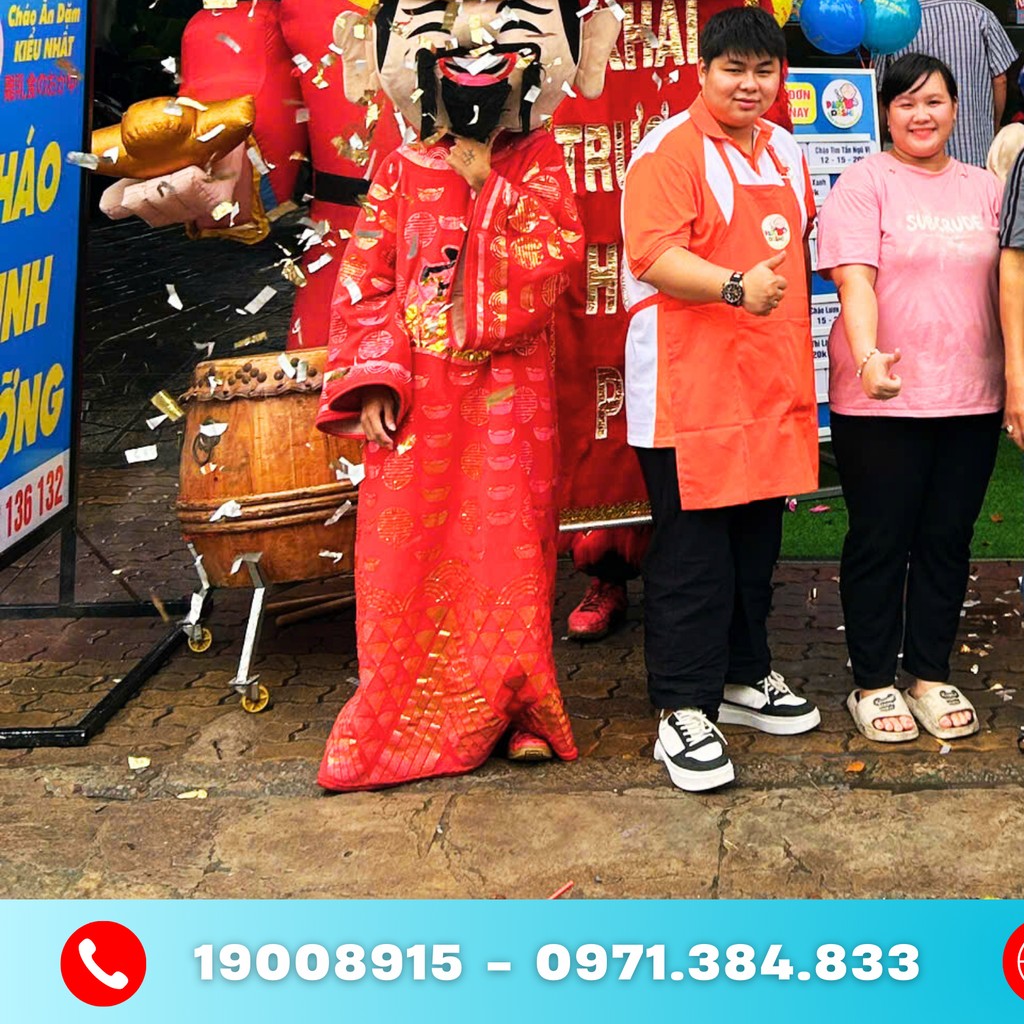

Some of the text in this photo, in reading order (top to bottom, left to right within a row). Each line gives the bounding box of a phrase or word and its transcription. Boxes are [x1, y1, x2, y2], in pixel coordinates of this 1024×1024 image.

[8, 2, 36, 27] Cháo
[14, 27, 42, 62] KIỂU
[0, 125, 62, 225] HÁO
[0, 255, 54, 343] INH
[5, 465, 64, 537] 136 132
